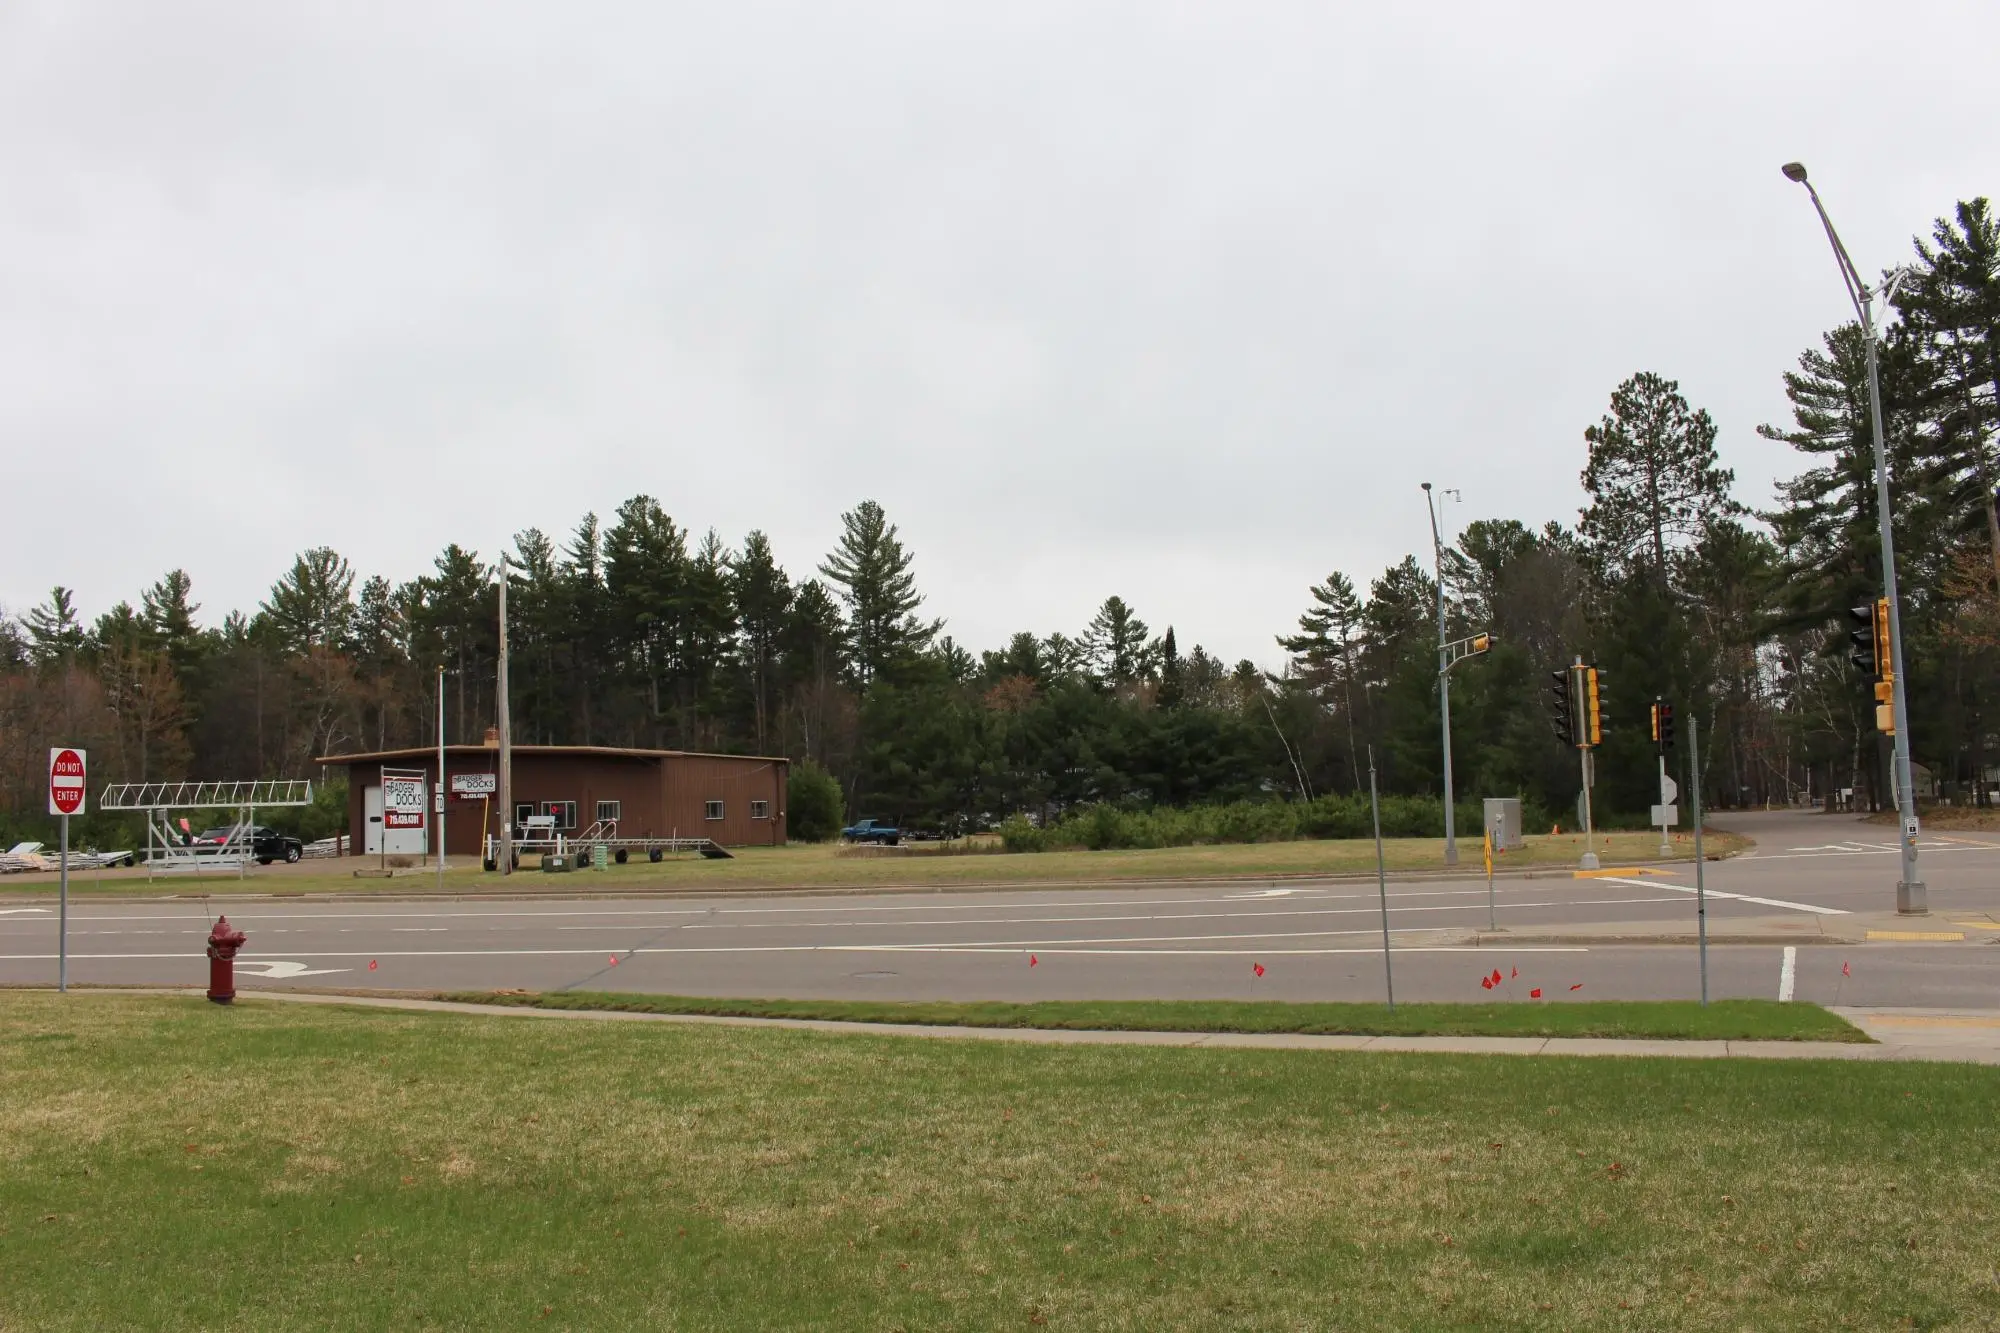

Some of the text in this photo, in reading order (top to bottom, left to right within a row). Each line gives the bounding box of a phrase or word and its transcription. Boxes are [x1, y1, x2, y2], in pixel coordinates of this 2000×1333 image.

[56, 762, 80, 772] DO NOT
[390, 782, 414, 794] BADGER
[466, 780, 494, 788] DOCKS
[57, 790, 78, 800] ENTER
[396, 794, 422, 805] DOCKS
